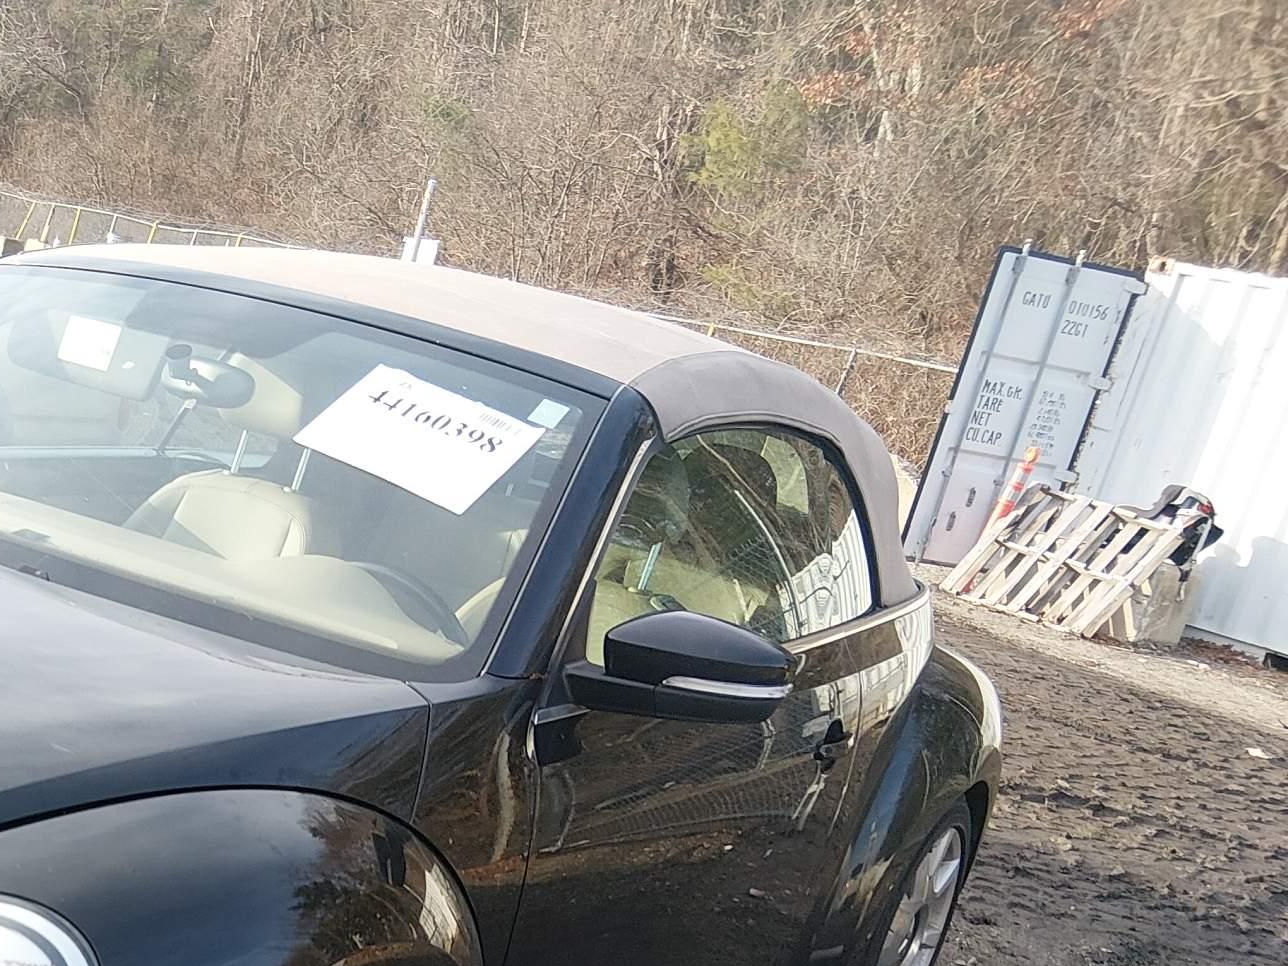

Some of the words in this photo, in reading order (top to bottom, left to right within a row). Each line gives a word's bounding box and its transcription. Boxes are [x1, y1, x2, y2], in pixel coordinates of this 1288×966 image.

[1022, 291, 1052, 309] GATU
[1067, 300, 1111, 320] 010156
[1060, 319, 1088, 339] 22G1
[977, 395, 1004, 413] TARE
[368, 390, 504, 453] 44160398
[970, 409, 992, 427] NET
